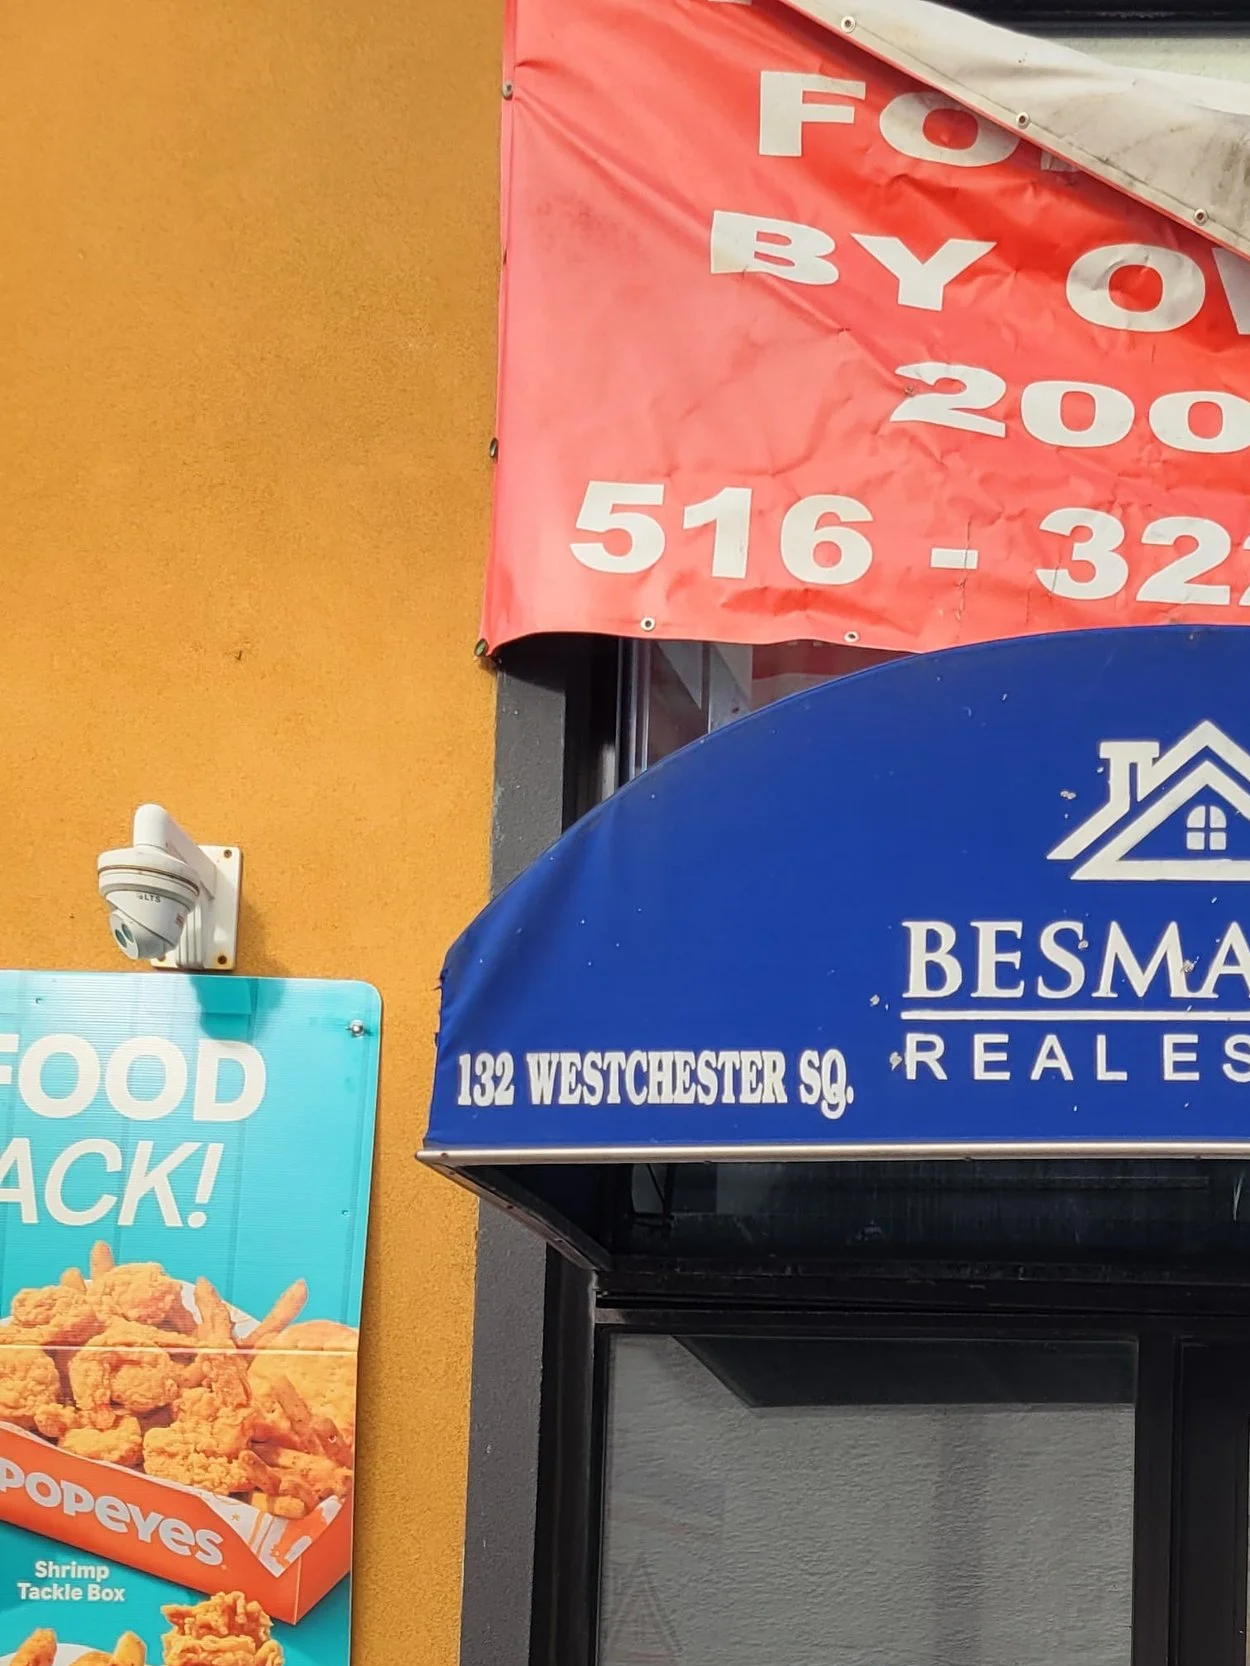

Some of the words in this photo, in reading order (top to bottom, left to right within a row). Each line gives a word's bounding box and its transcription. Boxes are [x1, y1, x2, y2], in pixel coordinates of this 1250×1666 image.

[758, 69, 1082, 173] FO
[709, 209, 997, 311] BY
[569, 480, 874, 586] 516
[930, 548, 979, 570] -
[457, 1051, 516, 1107] 132
[526, 1050, 788, 1107] WESTCHESTER
[800, 1048, 855, 1120] SQ.
[905, 1033, 1128, 1081] REAL
[17, 1582, 83, 1601] Tackle
[87, 1583, 126, 1602] Box
[34, 1560, 110, 1581] Shrimp
